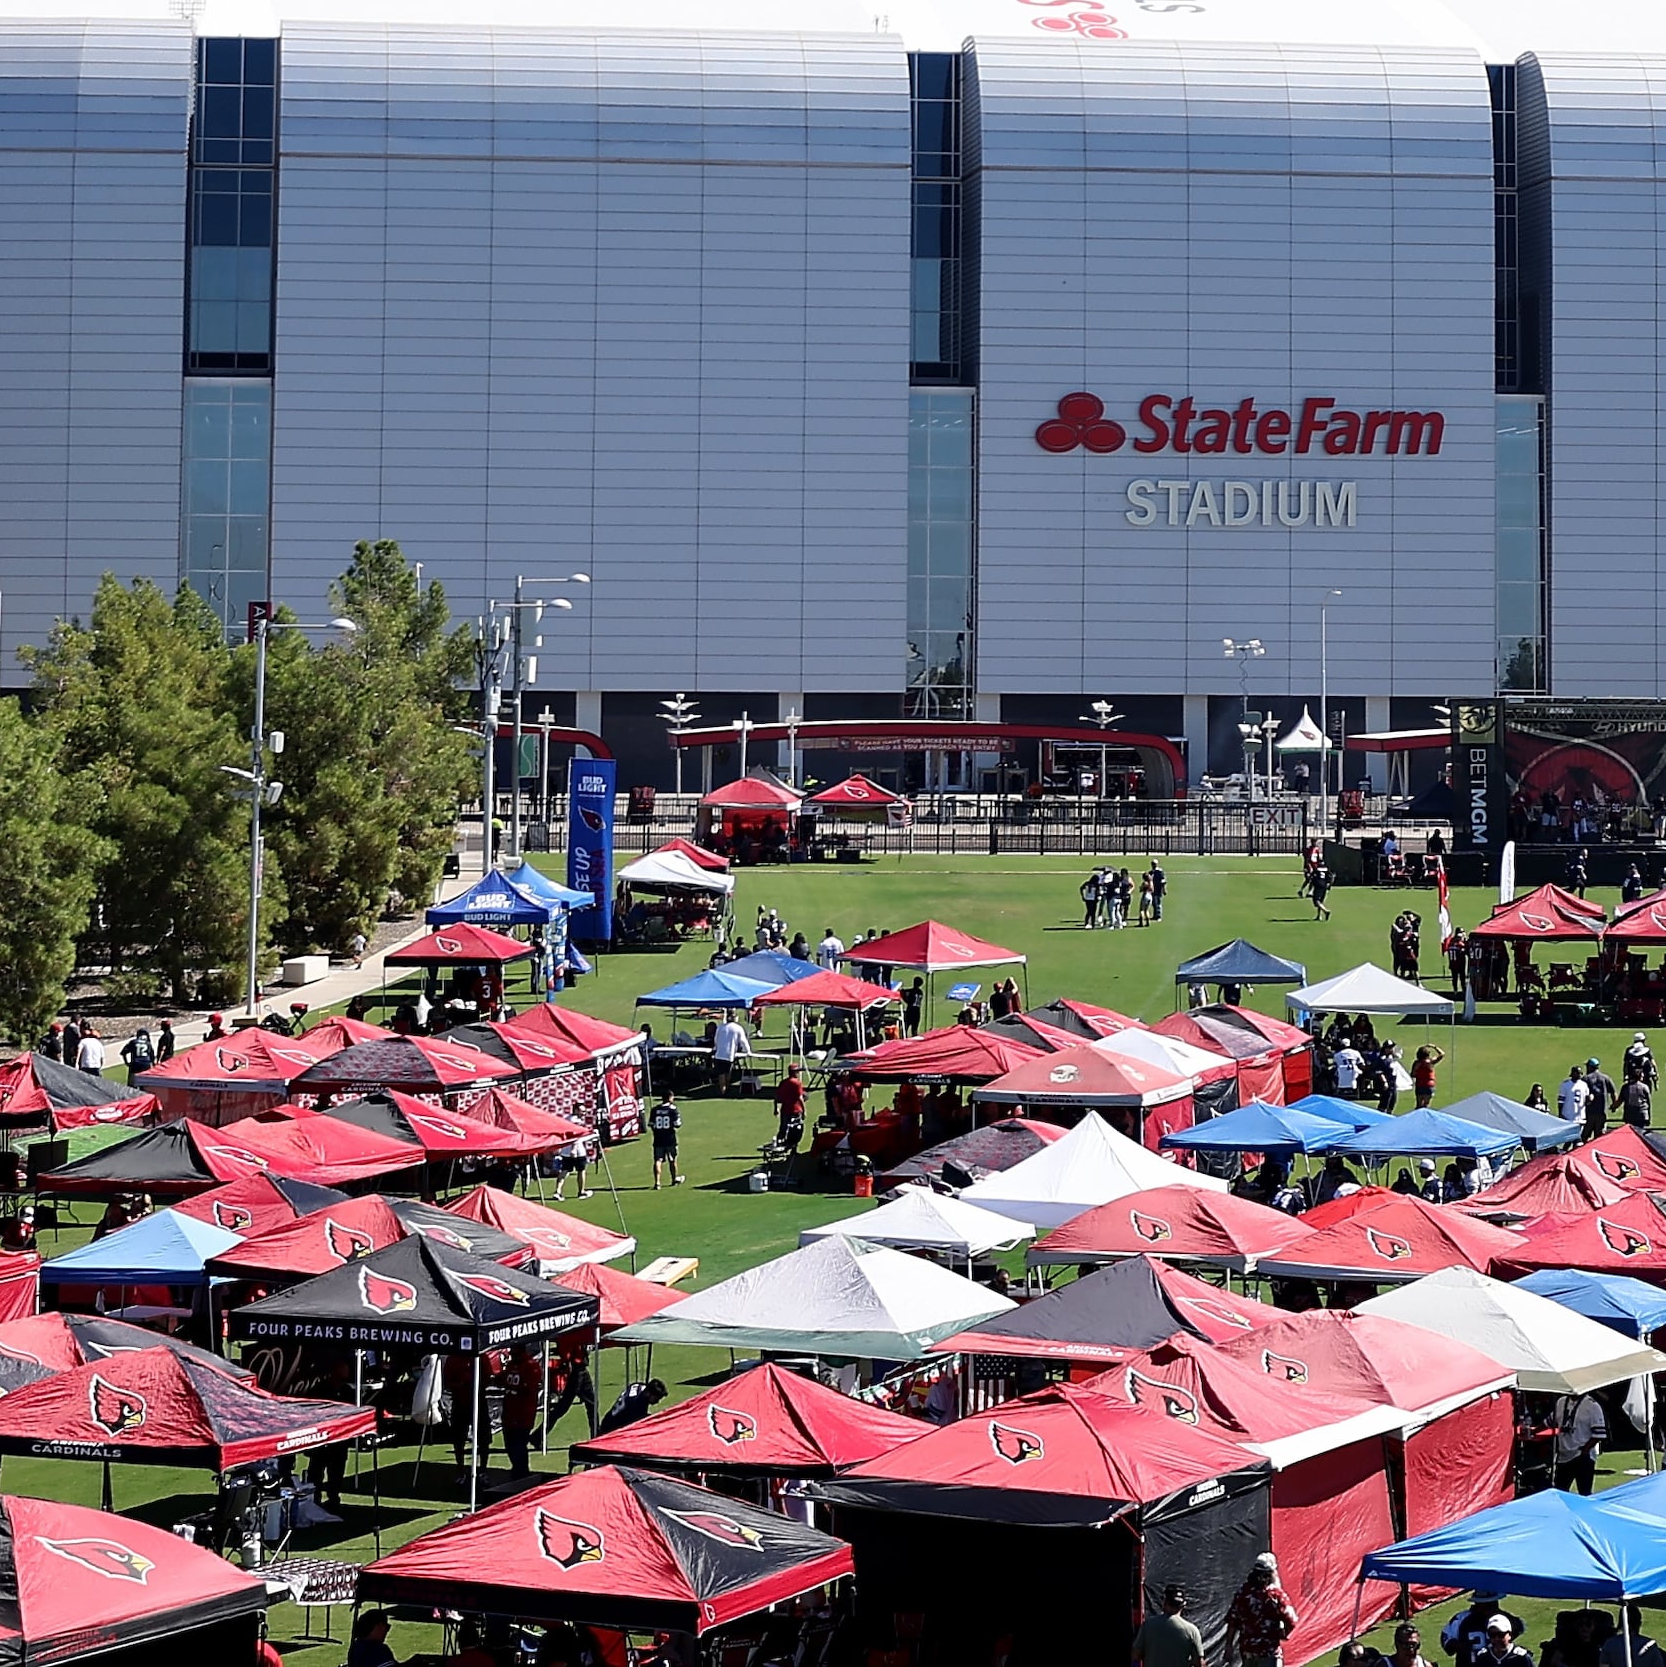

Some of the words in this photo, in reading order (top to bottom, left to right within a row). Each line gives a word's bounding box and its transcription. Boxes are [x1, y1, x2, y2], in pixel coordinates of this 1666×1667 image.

[1133, 394, 1445, 454] StateFarm
[1125, 480, 1358, 528] STADIUM
[582, 776, 603, 785] BUD
[578, 784, 608, 793] LIGHT
[1468, 748, 1489, 845] BETMGM
[1251, 808, 1303, 825] EXIT
[464, 913, 484, 922] BUD
[486, 914, 512, 922] LIGHT
[482, 985, 492, 999] 3
[136, 1043, 149, 1057] 12
[655, 1116, 671, 1129] 88
[249, 1322, 289, 1335] FOUR
[294, 1324, 343, 1339] PEAKS
[349, 1327, 423, 1344] BREWING
[430, 1332, 454, 1346] CO.
[488, 1328, 512, 1345] FOUR
[512, 1320, 539, 1339] PEAKS
[539, 1311, 576, 1332] BREWING
[576, 1309, 590, 1323] CO.
[1047, 1347, 1125, 1358] CARDINALS
[1066, 1344, 1111, 1352] ARIZONA
[276, 1431, 331, 1451] CARDINALS
[31, 1444, 122, 1458] CARDINALS
[1189, 1485, 1225, 1506] CARDINALS
